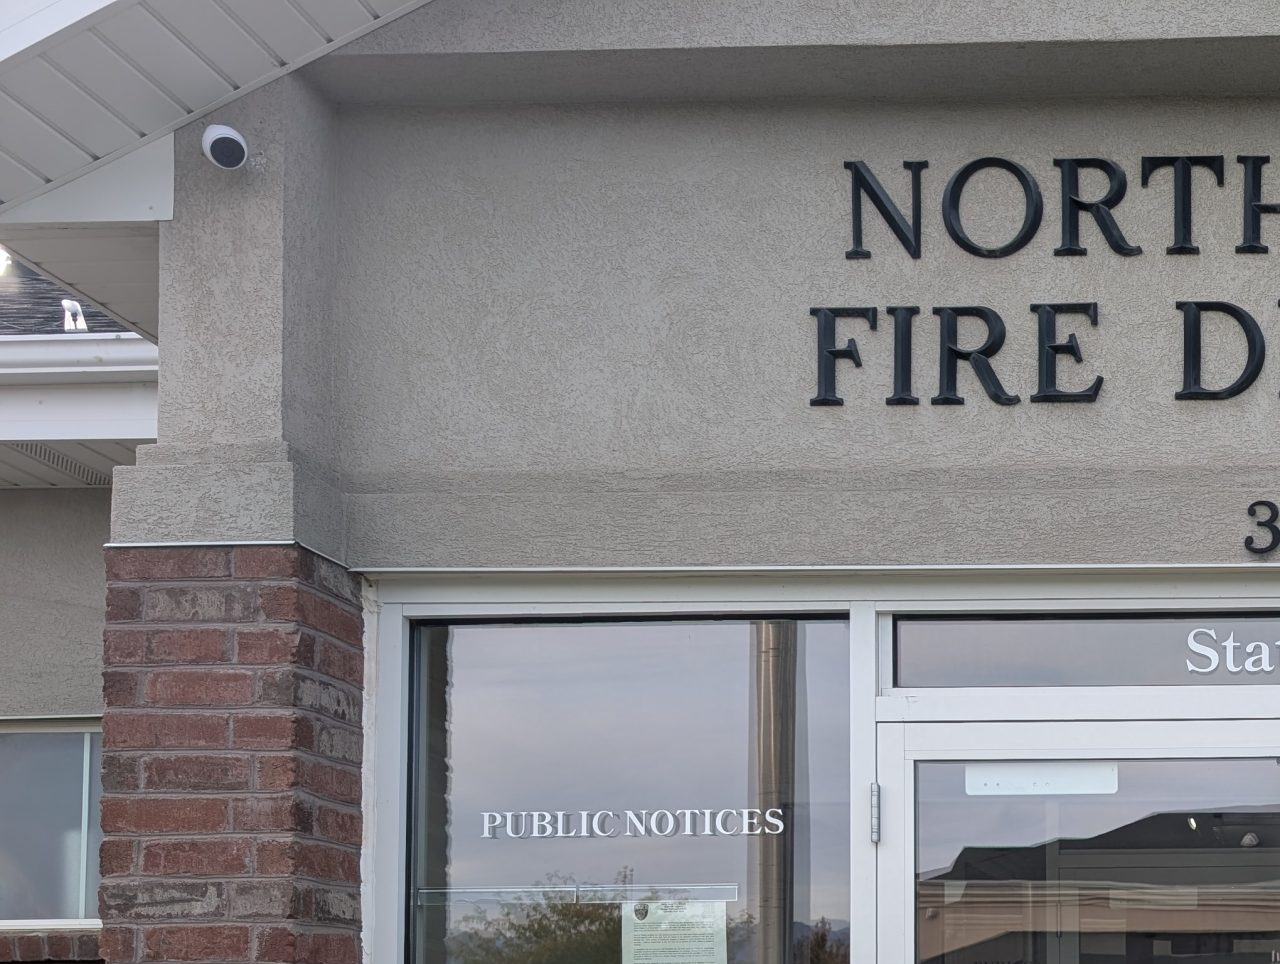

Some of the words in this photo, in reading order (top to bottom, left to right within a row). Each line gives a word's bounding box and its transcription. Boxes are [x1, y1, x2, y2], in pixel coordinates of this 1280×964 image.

[809, 301, 1104, 407] FIRE
[480, 810, 614, 838] PUBLIC
[623, 808, 785, 836] NOTICES
